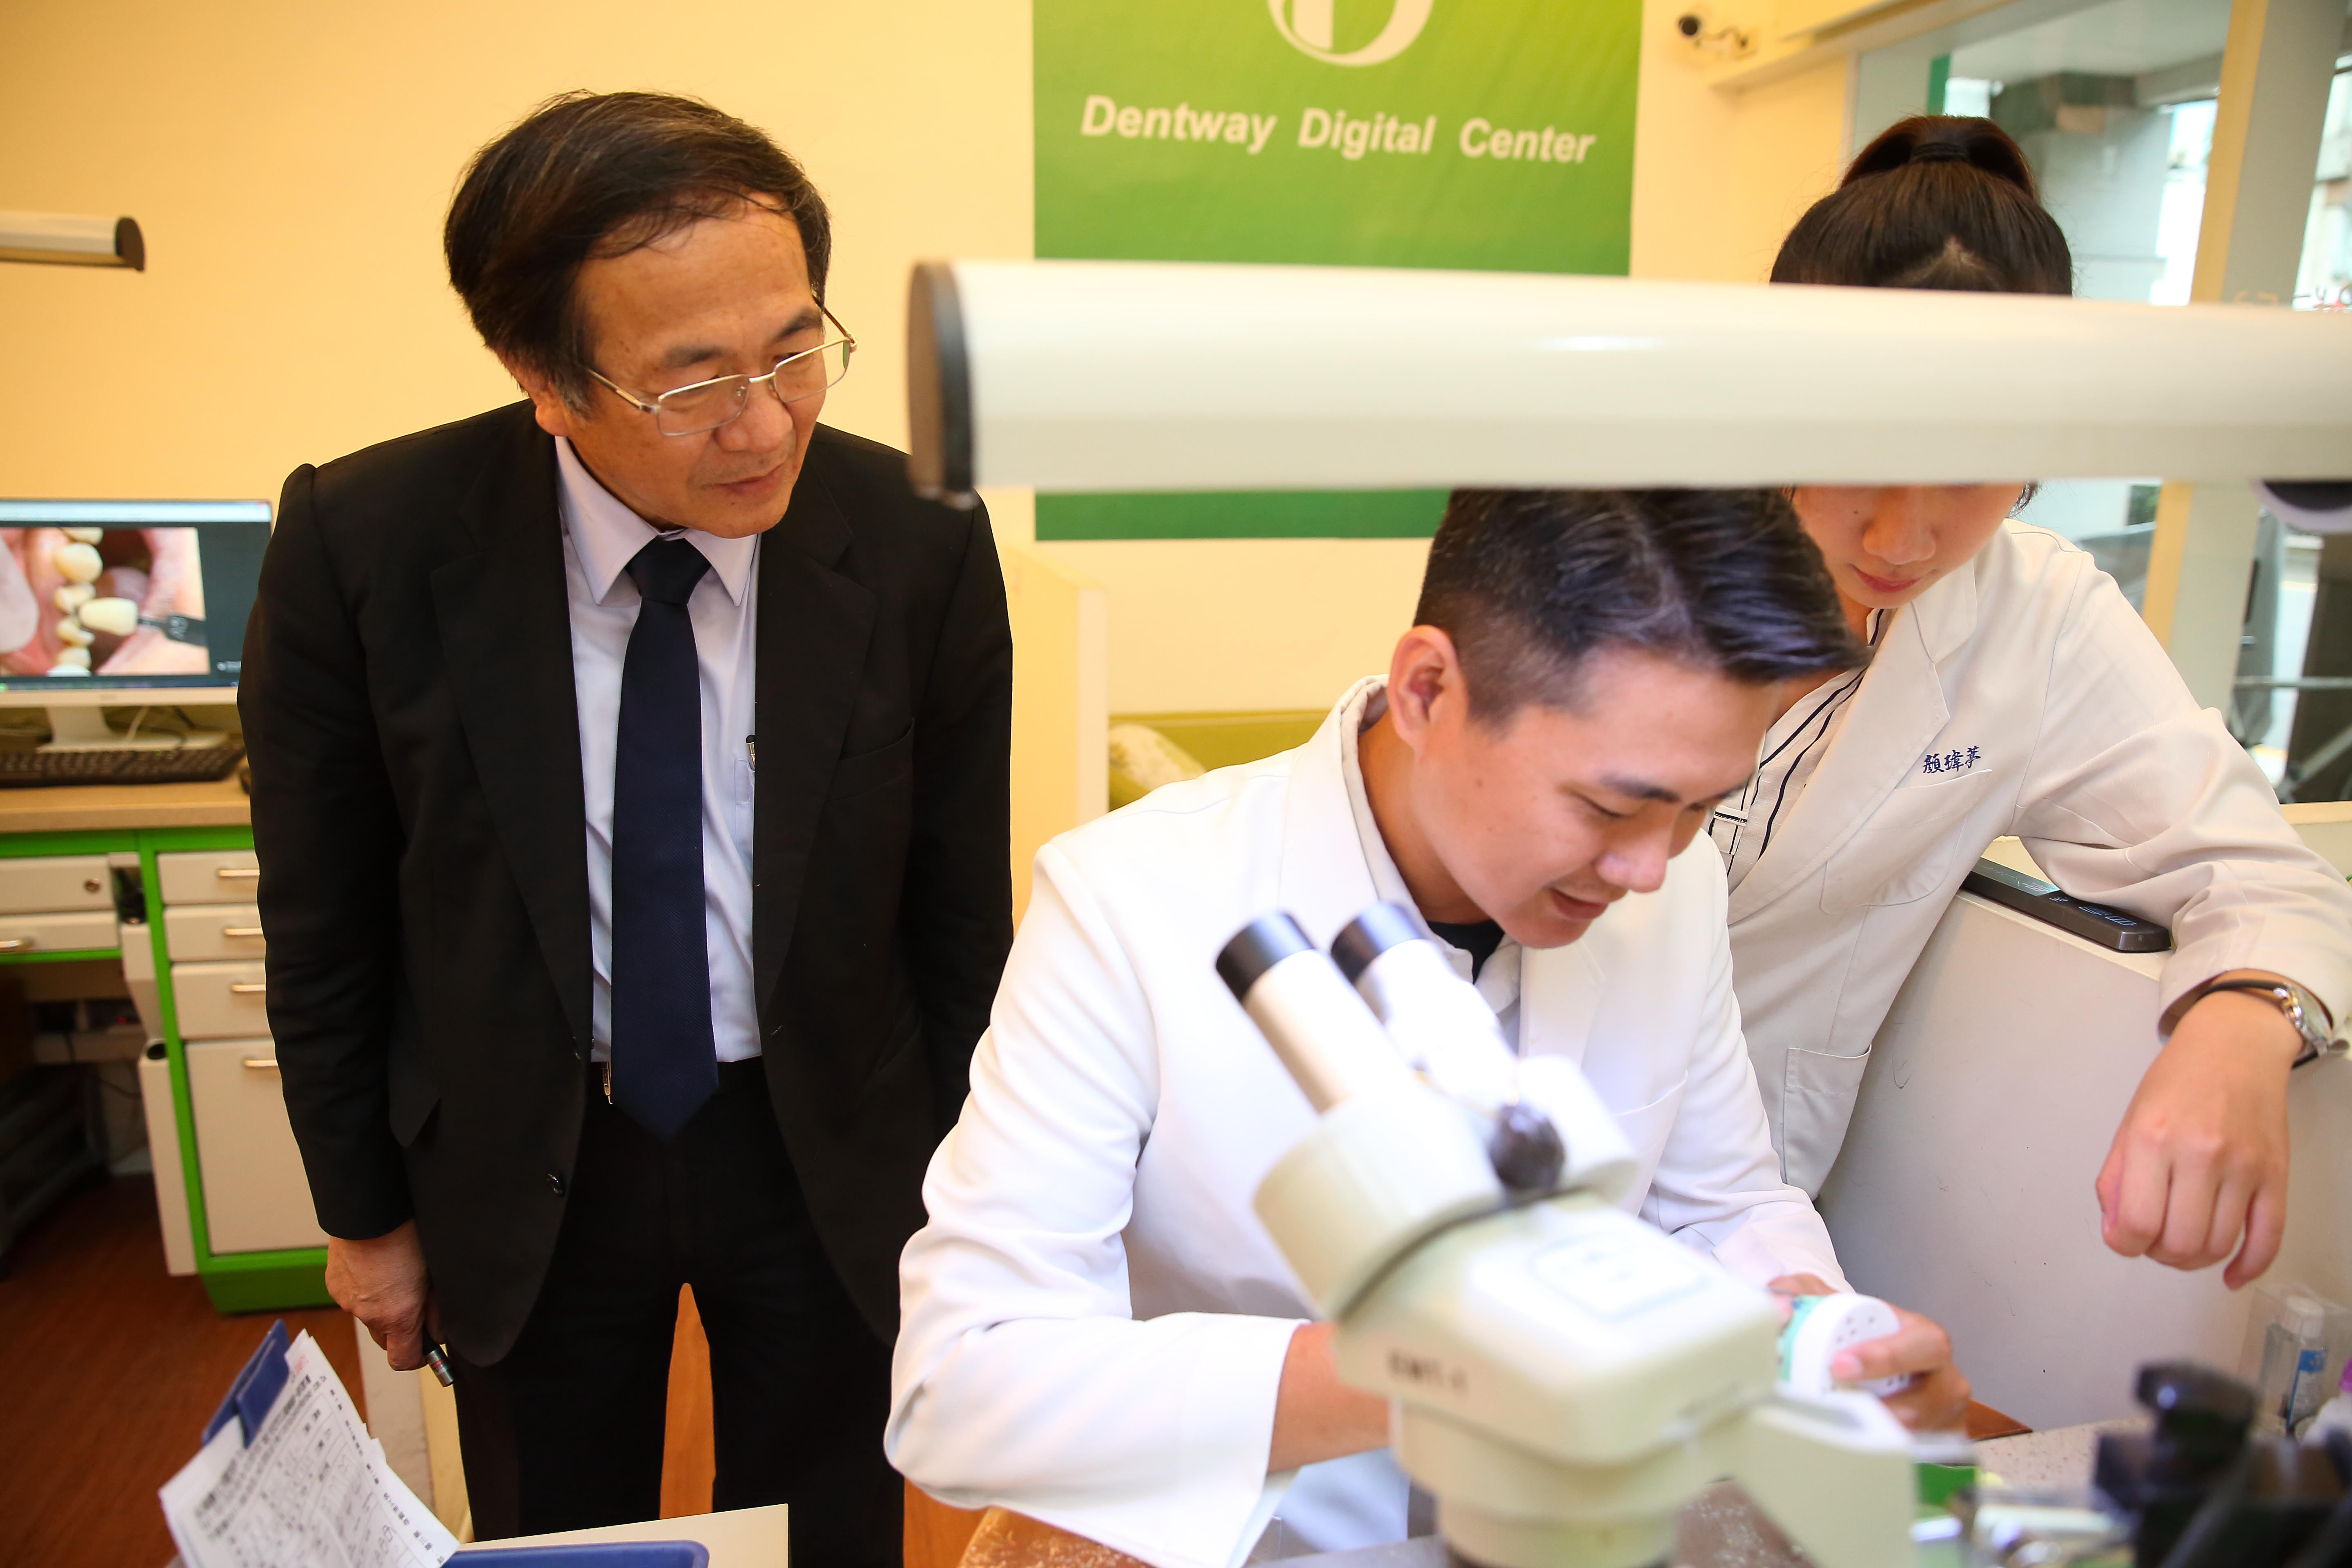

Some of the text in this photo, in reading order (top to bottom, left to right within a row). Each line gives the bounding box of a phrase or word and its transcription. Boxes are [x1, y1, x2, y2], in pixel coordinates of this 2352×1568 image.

[1080, 94, 1597, 163] Dentway Digital Center
